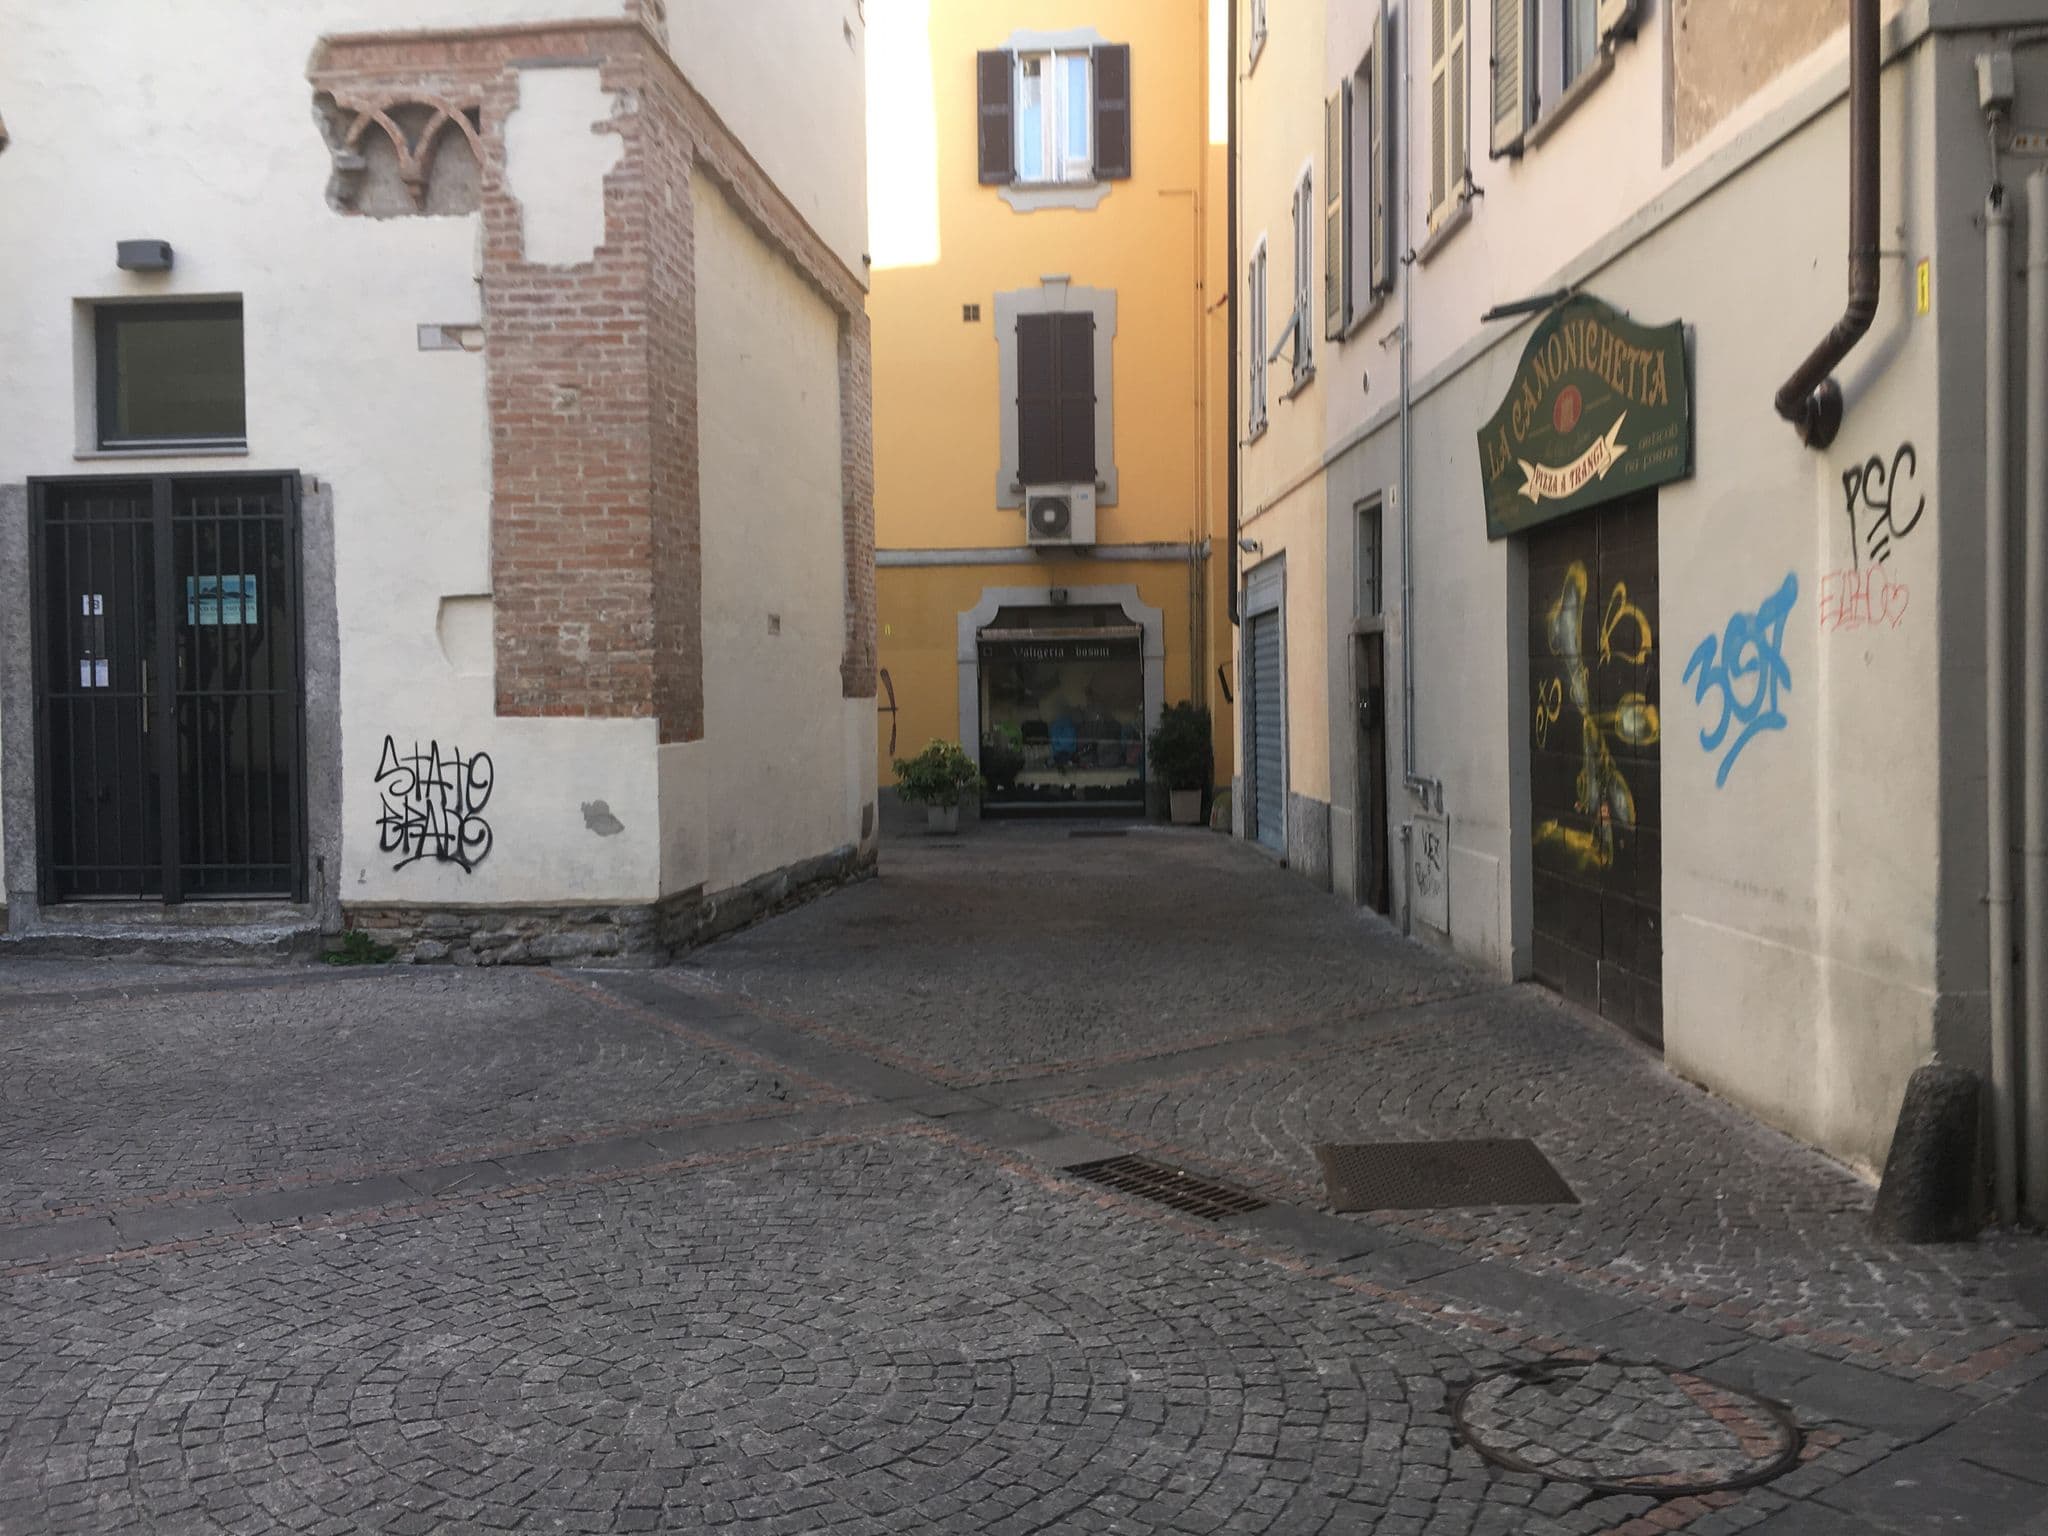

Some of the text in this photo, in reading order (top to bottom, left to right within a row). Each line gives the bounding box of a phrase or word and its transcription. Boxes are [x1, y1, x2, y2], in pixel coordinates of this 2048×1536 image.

[1488, 319, 1668, 481] LA CANONICHETTA
[1535, 468, 1558, 493] PIZZA
[374, 733, 495, 814] STATO
